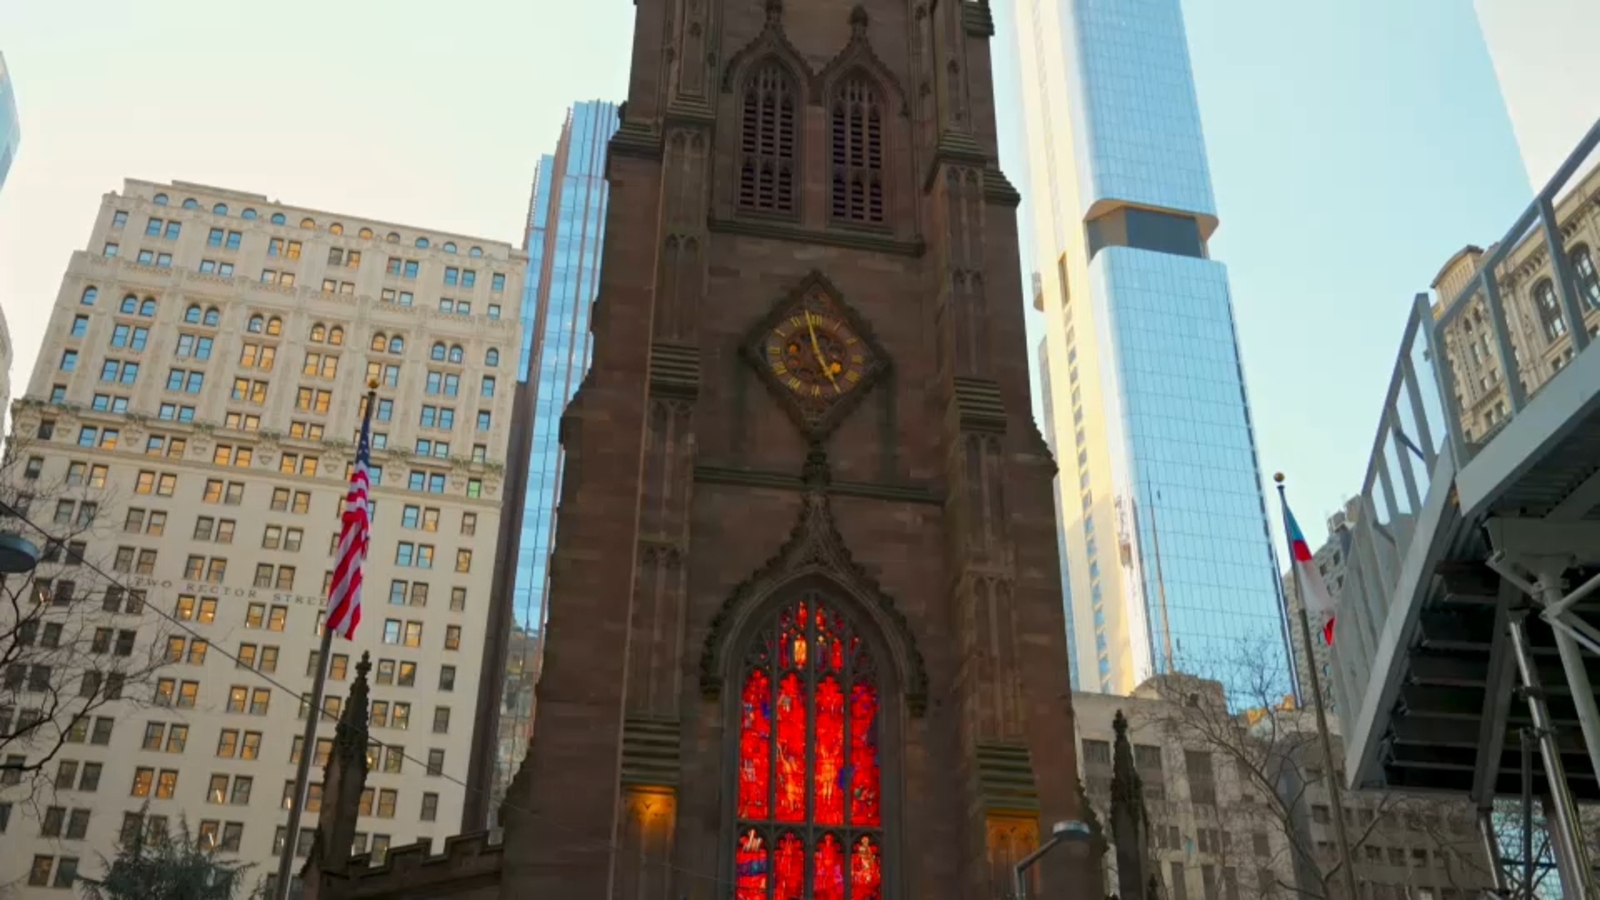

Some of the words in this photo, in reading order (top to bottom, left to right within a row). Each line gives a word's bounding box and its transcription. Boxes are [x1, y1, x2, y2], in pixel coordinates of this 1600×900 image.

[134, 576, 172, 588] TWO
[186, 583, 257, 598] RECTOR
[273, 593, 328, 606] STREE
